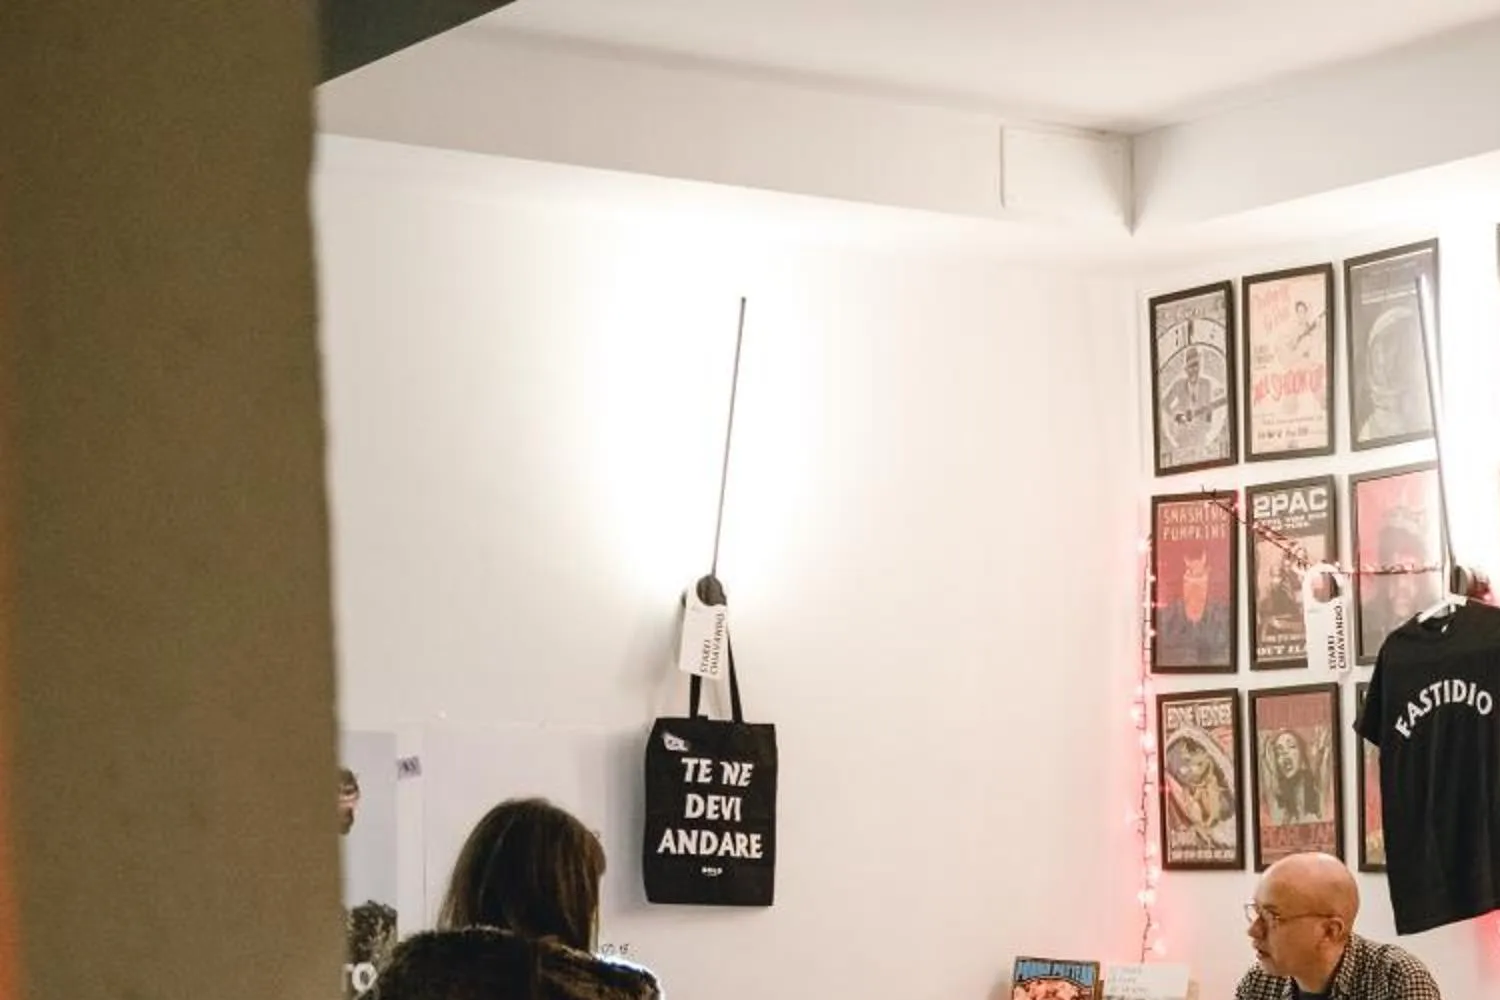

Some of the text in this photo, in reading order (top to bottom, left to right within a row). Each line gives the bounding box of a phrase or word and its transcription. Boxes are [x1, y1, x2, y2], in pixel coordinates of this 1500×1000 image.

[1163, 505, 1229, 526] SMASHING
[1253, 488, 1327, 518] 2PAC
[1163, 523, 1226, 542] PUMPKINS
[1395, 679, 1493, 739] FASTIDIO
[682, 757, 753, 787] TE NE
[684, 793, 741, 822] DEVI
[657, 828, 763, 859] ANDARE
